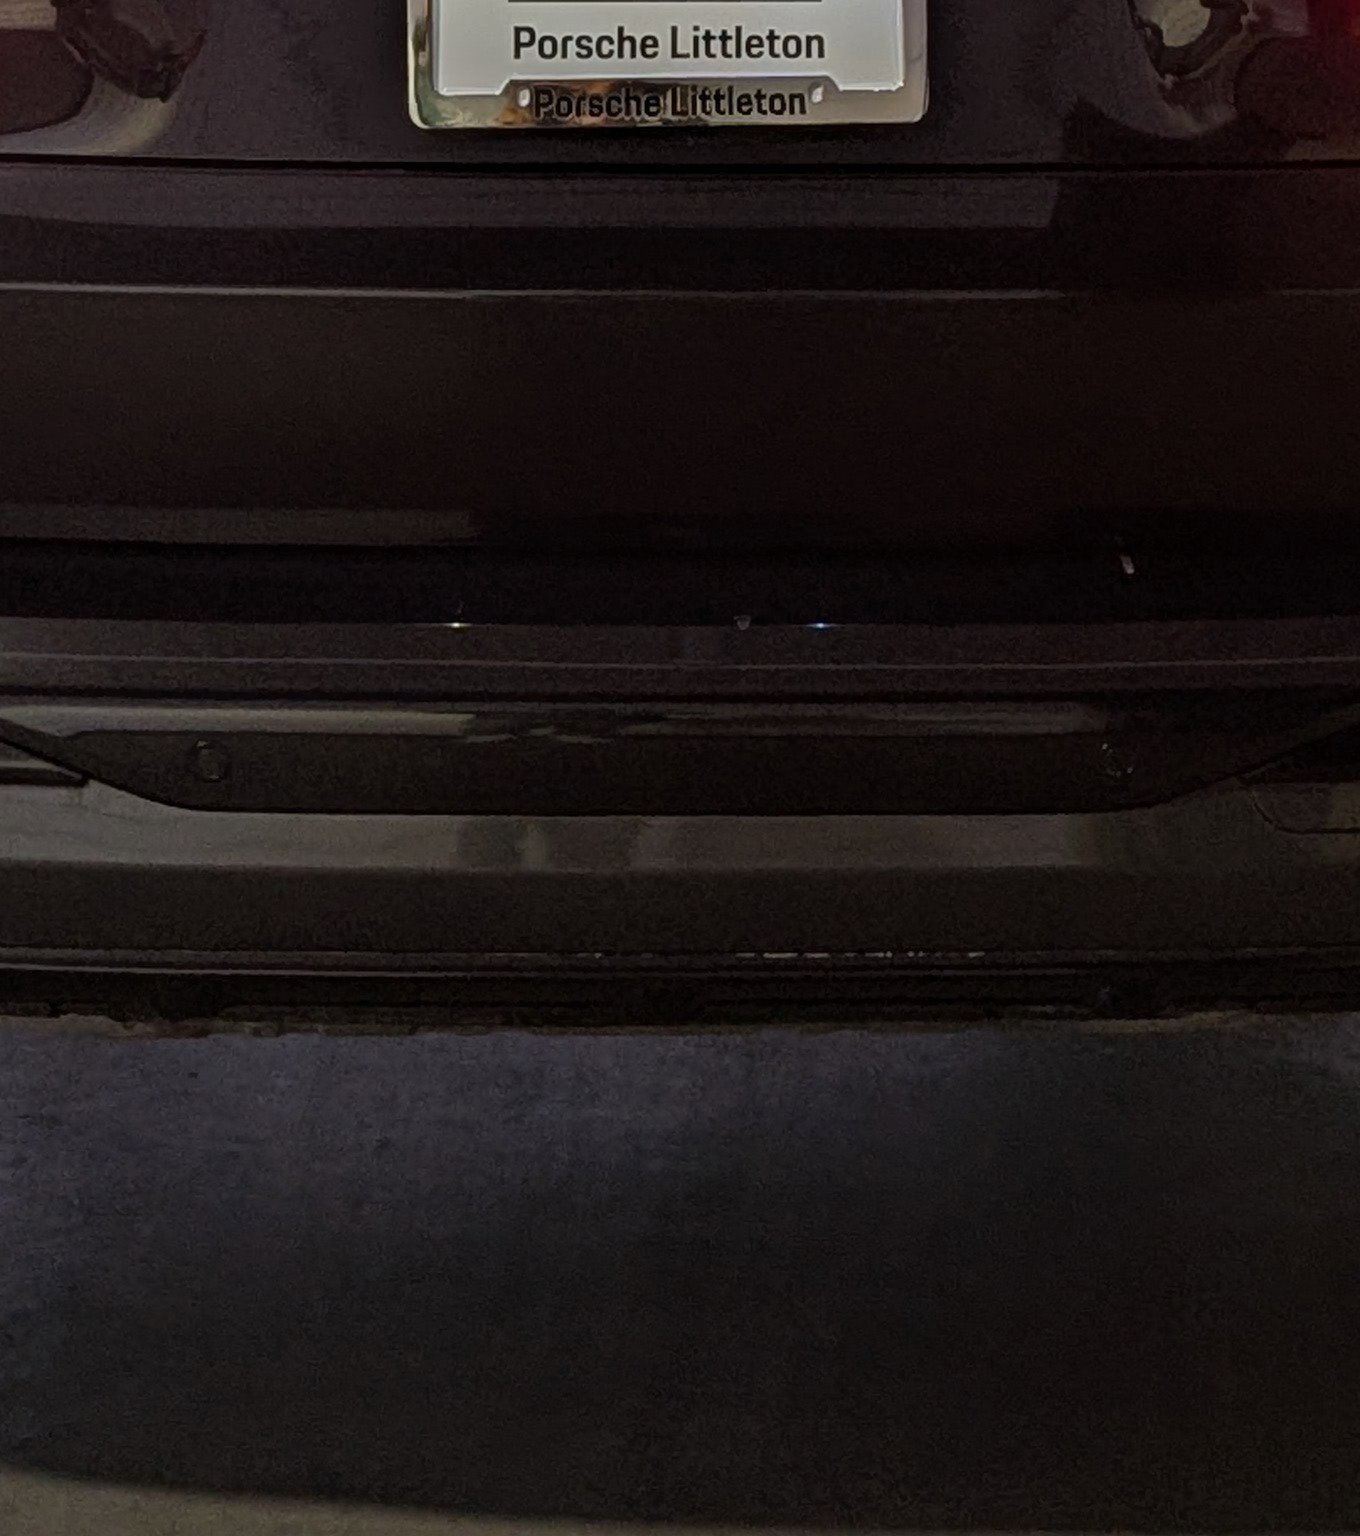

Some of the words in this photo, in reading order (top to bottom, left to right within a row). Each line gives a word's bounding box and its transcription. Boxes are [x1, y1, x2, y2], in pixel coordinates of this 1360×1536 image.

[513, 25, 659, 60] Porsche
[670, 25, 826, 59] Littleton
[534, 84, 662, 118] Porsche
[671, 81, 807, 116] Littleton
